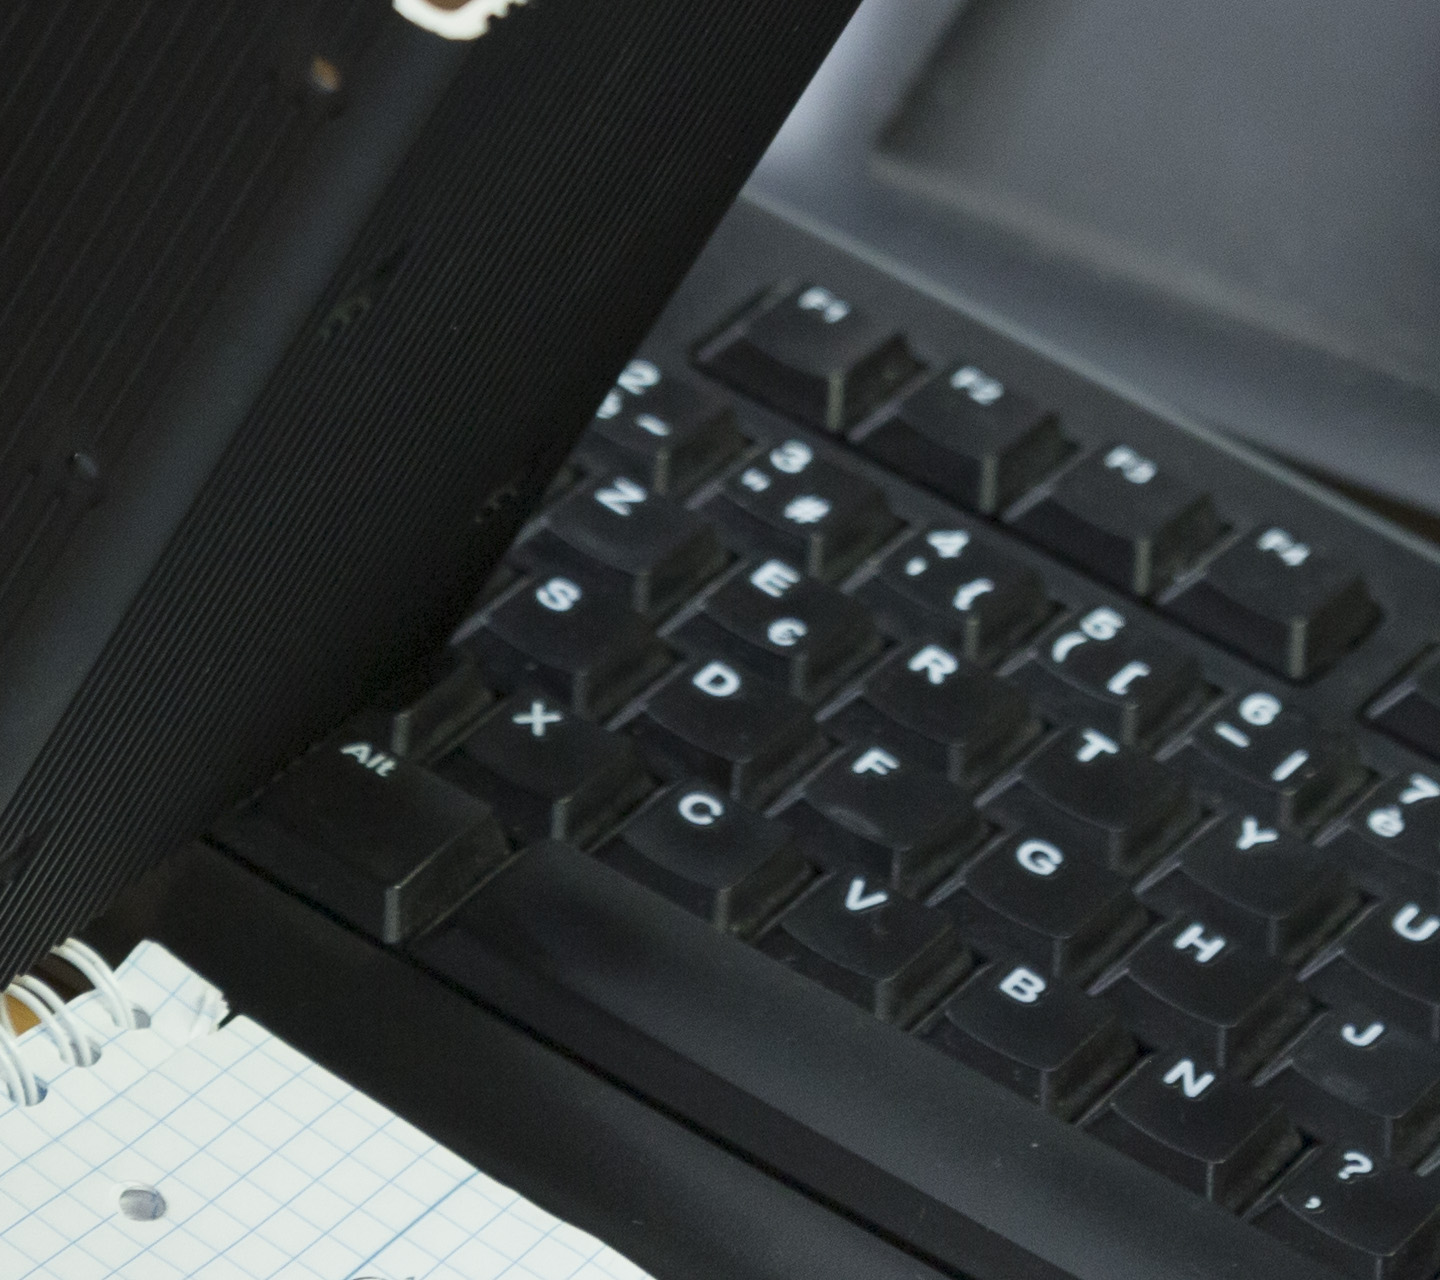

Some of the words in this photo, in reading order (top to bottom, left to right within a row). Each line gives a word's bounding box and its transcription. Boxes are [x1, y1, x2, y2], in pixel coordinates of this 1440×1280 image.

[768, 440, 814, 476] 3
[598, 478, 648, 518] Z
[926, 529, 971, 560] 4
[534, 576, 582, 614] S
[748, 558, 800, 599] E
[1078, 605, 1126, 644] 5
[691, 660, 742, 699] D
[907, 643, 960, 687] R
[512, 700, 563, 738] X
[1237, 691, 1283, 728] 6
[340, 739, 396, 780] Alt
[850, 746, 900, 777] F
[1075, 728, 1120, 764] T
[676, 791, 725, 827] C
[1235, 816, 1280, 852] Y
[1014, 838, 1065, 878] G
[843, 876, 890, 913] V
[1172, 922, 1228, 965] H
[997, 965, 1048, 1005] B
[1339, 1021, 1386, 1049] J
[1161, 1057, 1217, 1100] N
